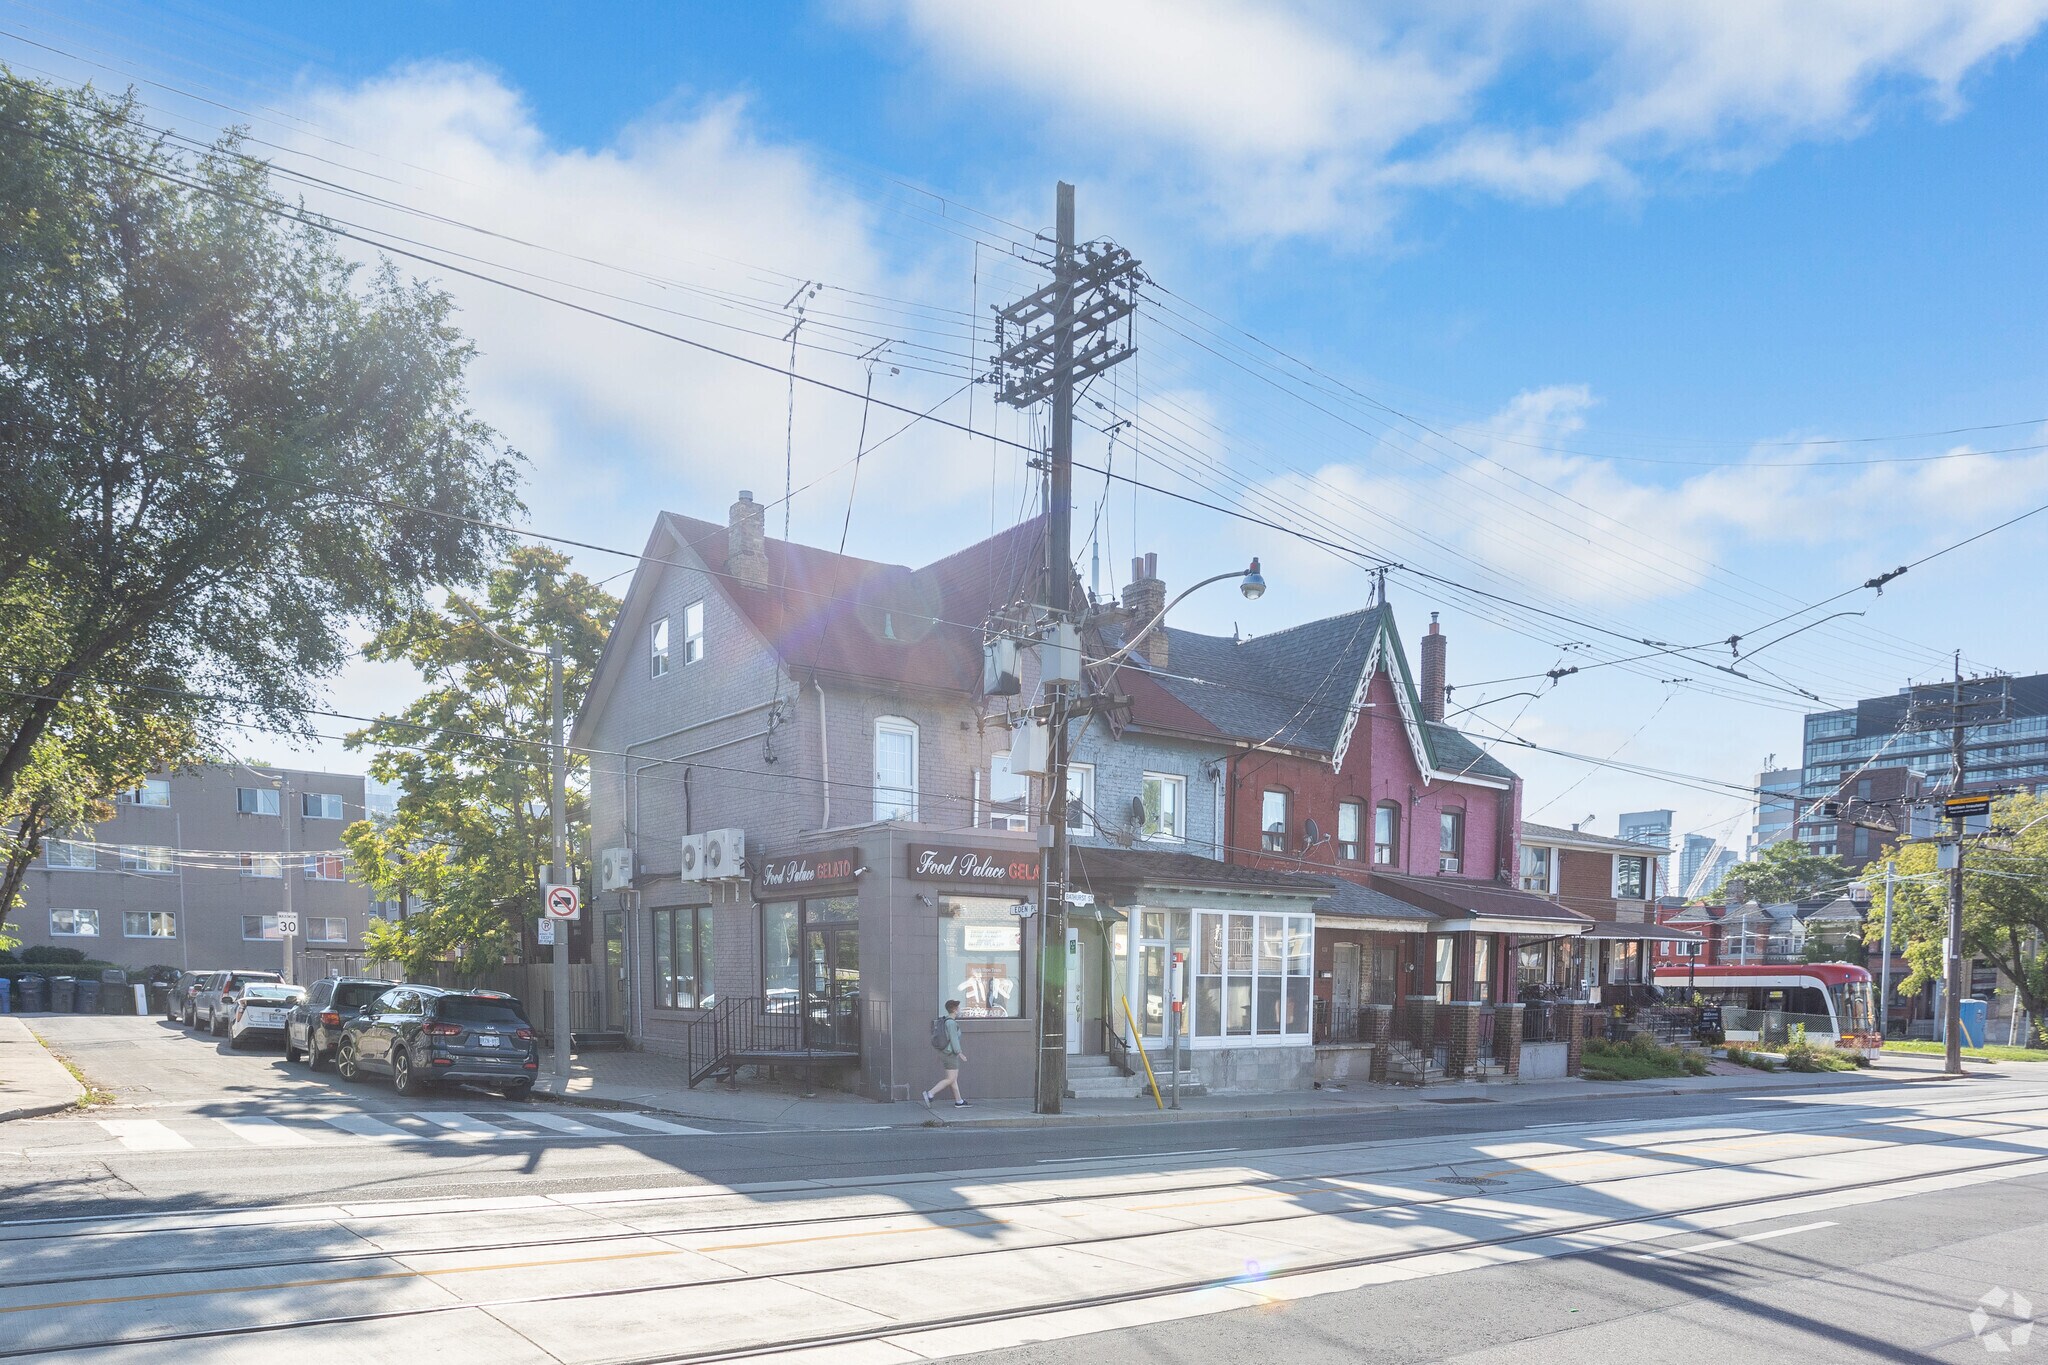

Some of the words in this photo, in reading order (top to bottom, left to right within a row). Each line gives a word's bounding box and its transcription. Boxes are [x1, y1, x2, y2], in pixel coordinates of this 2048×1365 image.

[916, 850, 958, 876] Food
[959, 853, 1006, 879] Palace
[763, 864, 786, 886] Food
[786, 859, 815, 883] Palace
[816, 859, 851, 879] GELATO
[1066, 893, 1087, 902] BATHURST
[1014, 905, 1028, 914] EDEN
[1030, 904, 1037, 912] PL
[280, 921, 296, 932] 30
